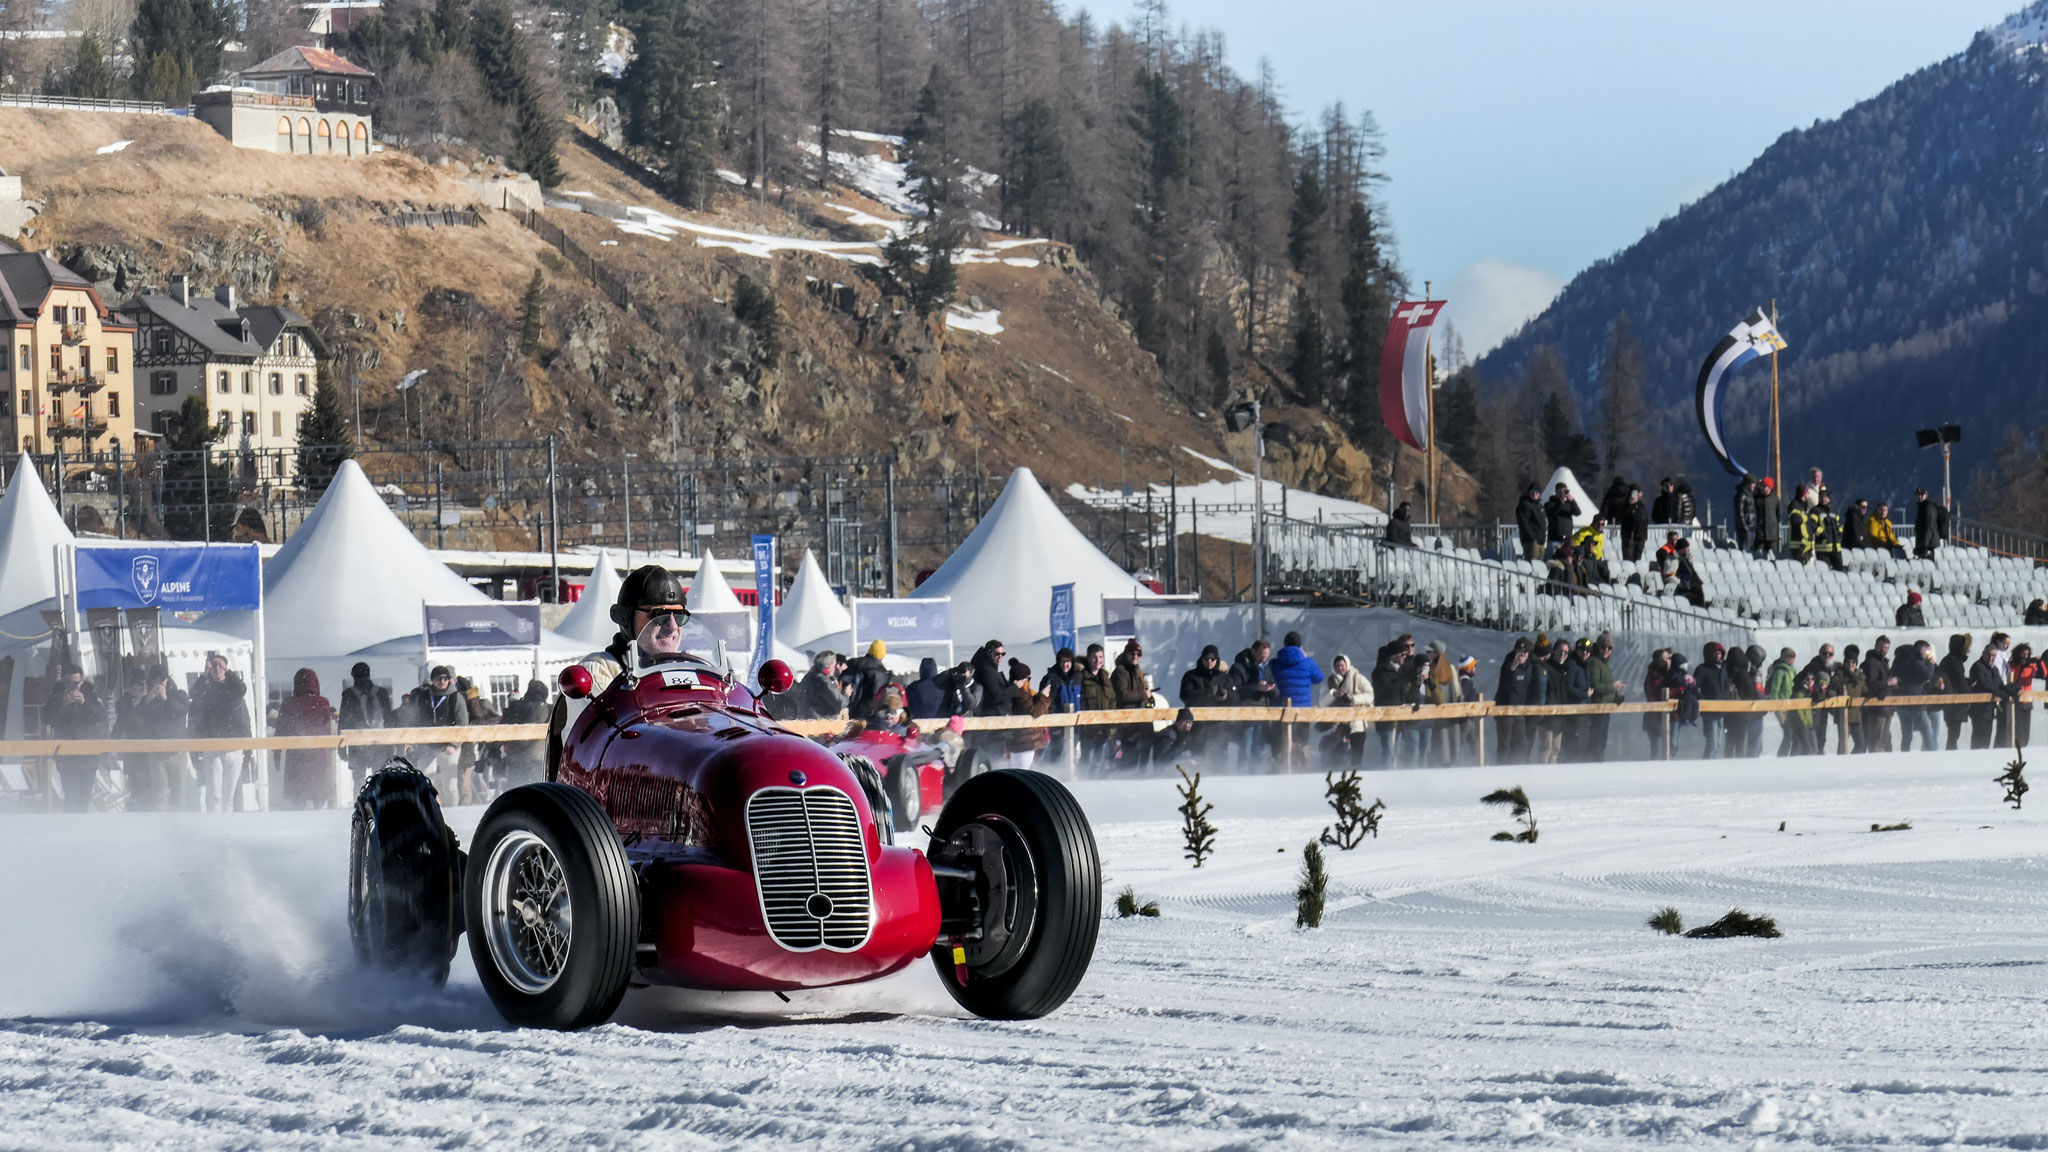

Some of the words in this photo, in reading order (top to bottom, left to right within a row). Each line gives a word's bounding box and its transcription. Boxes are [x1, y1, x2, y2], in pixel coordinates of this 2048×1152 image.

[161, 582, 191, 594] ALPINE
[887, 616, 917, 628] WELCOME
[671, 677, 693, 685] 86
